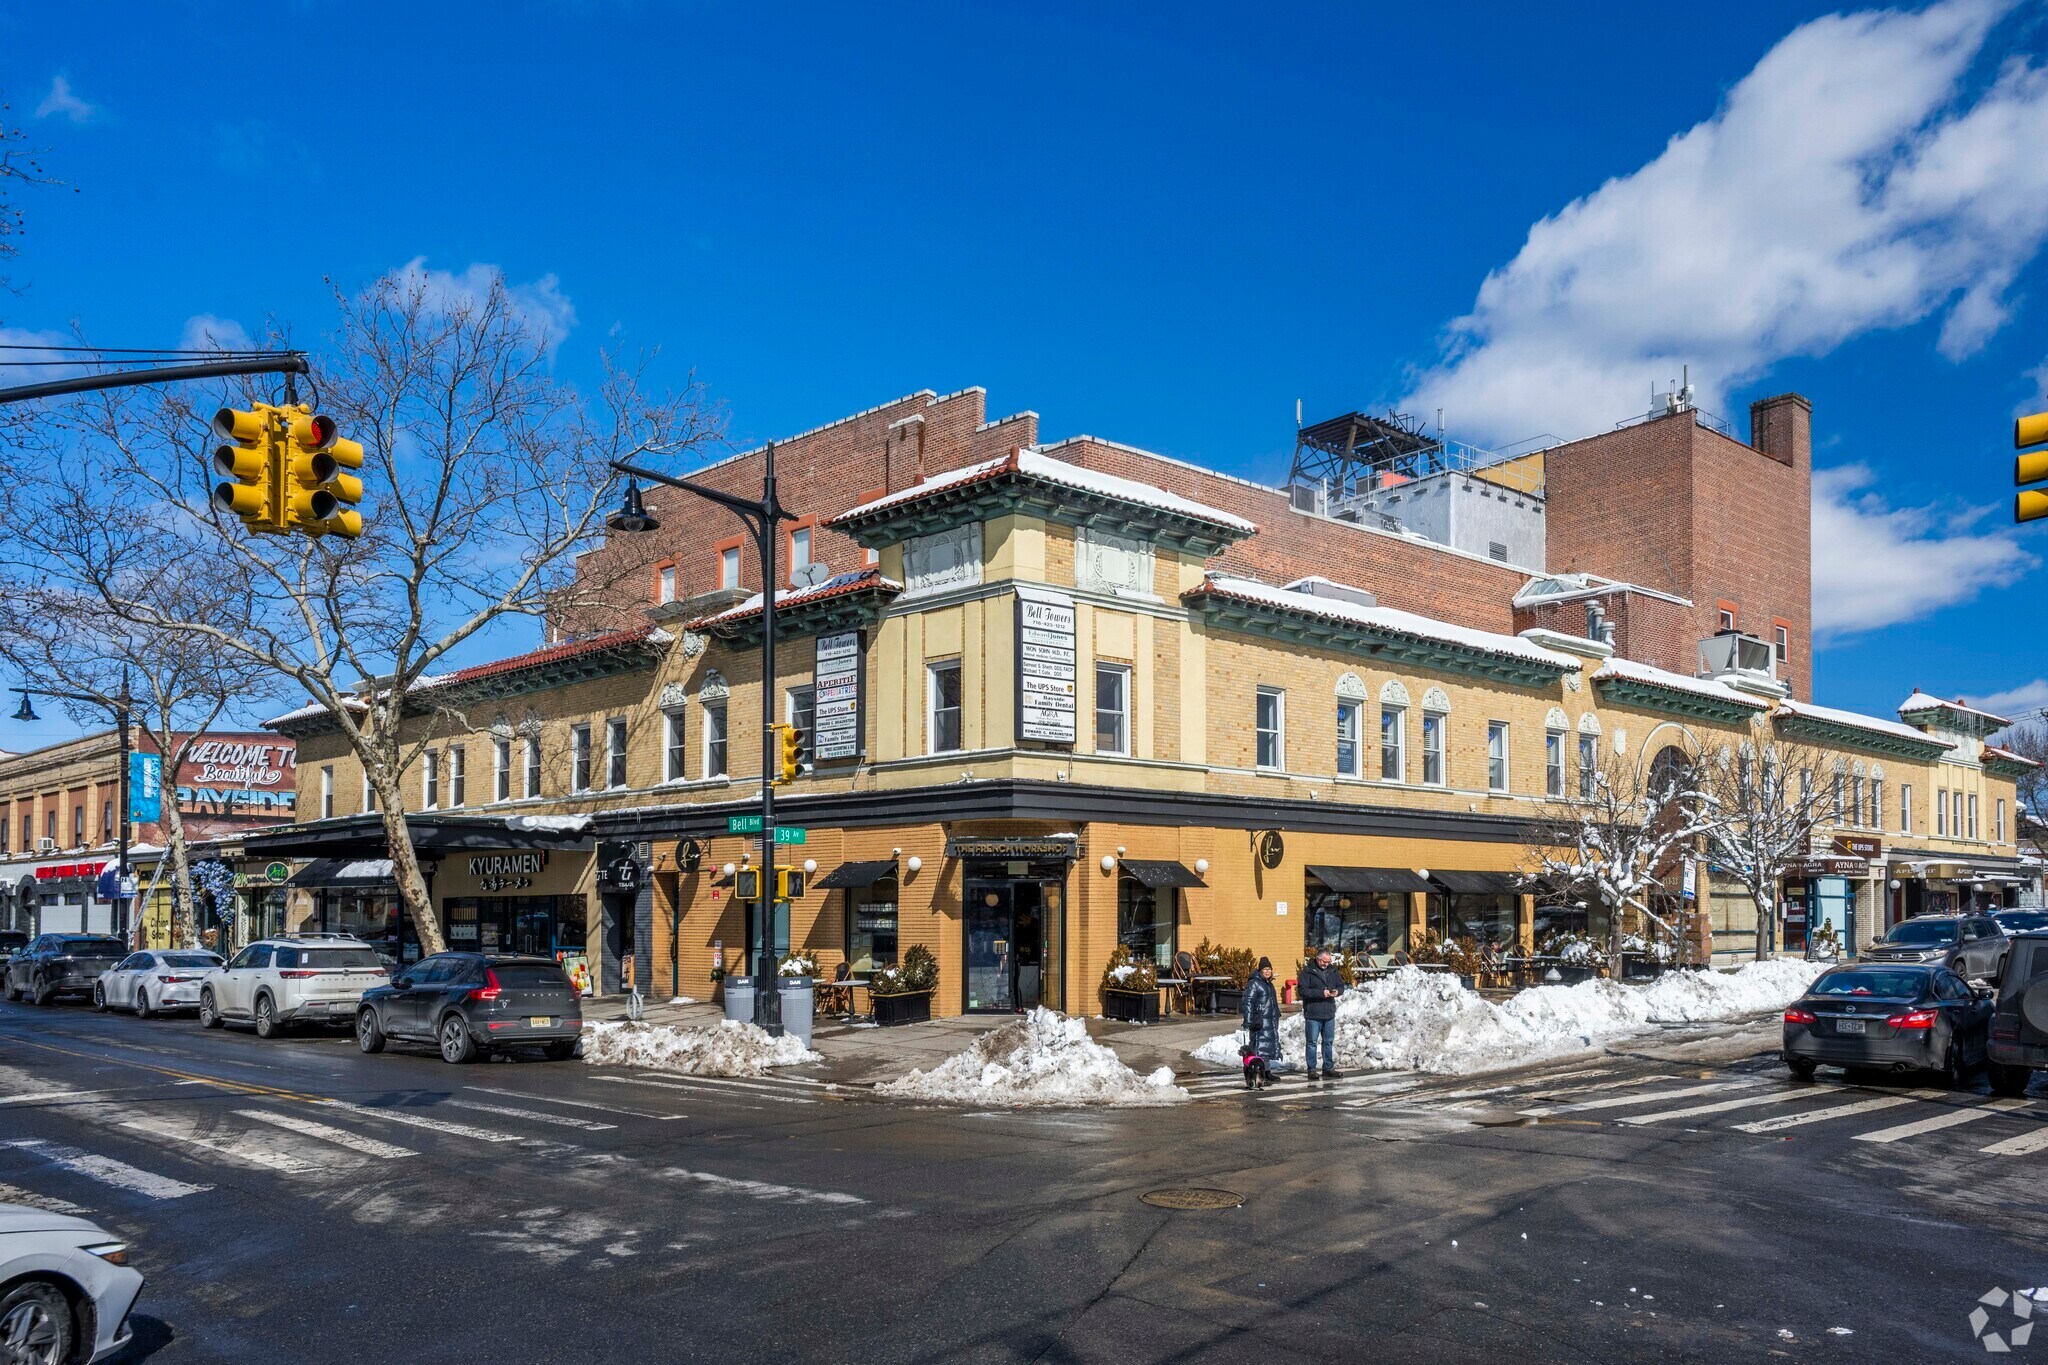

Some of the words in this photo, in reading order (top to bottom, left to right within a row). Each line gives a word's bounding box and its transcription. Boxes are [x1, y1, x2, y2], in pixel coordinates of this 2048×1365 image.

[1026, 604, 1042, 619] Bell
[1045, 608, 1071, 623] Towers
[817, 674, 856, 688] APERITIF
[174, 740, 274, 768] WELCOME
[194, 762, 281, 790] Beautiful
[732, 818, 747, 831] Bell
[781, 830, 789, 841] 39
[957, 844, 974, 853] THE
[976, 844, 1012, 853] FRENCH
[1013, 844, 1068, 853] WORKSHOP
[469, 854, 540, 875] KYURAMEN
